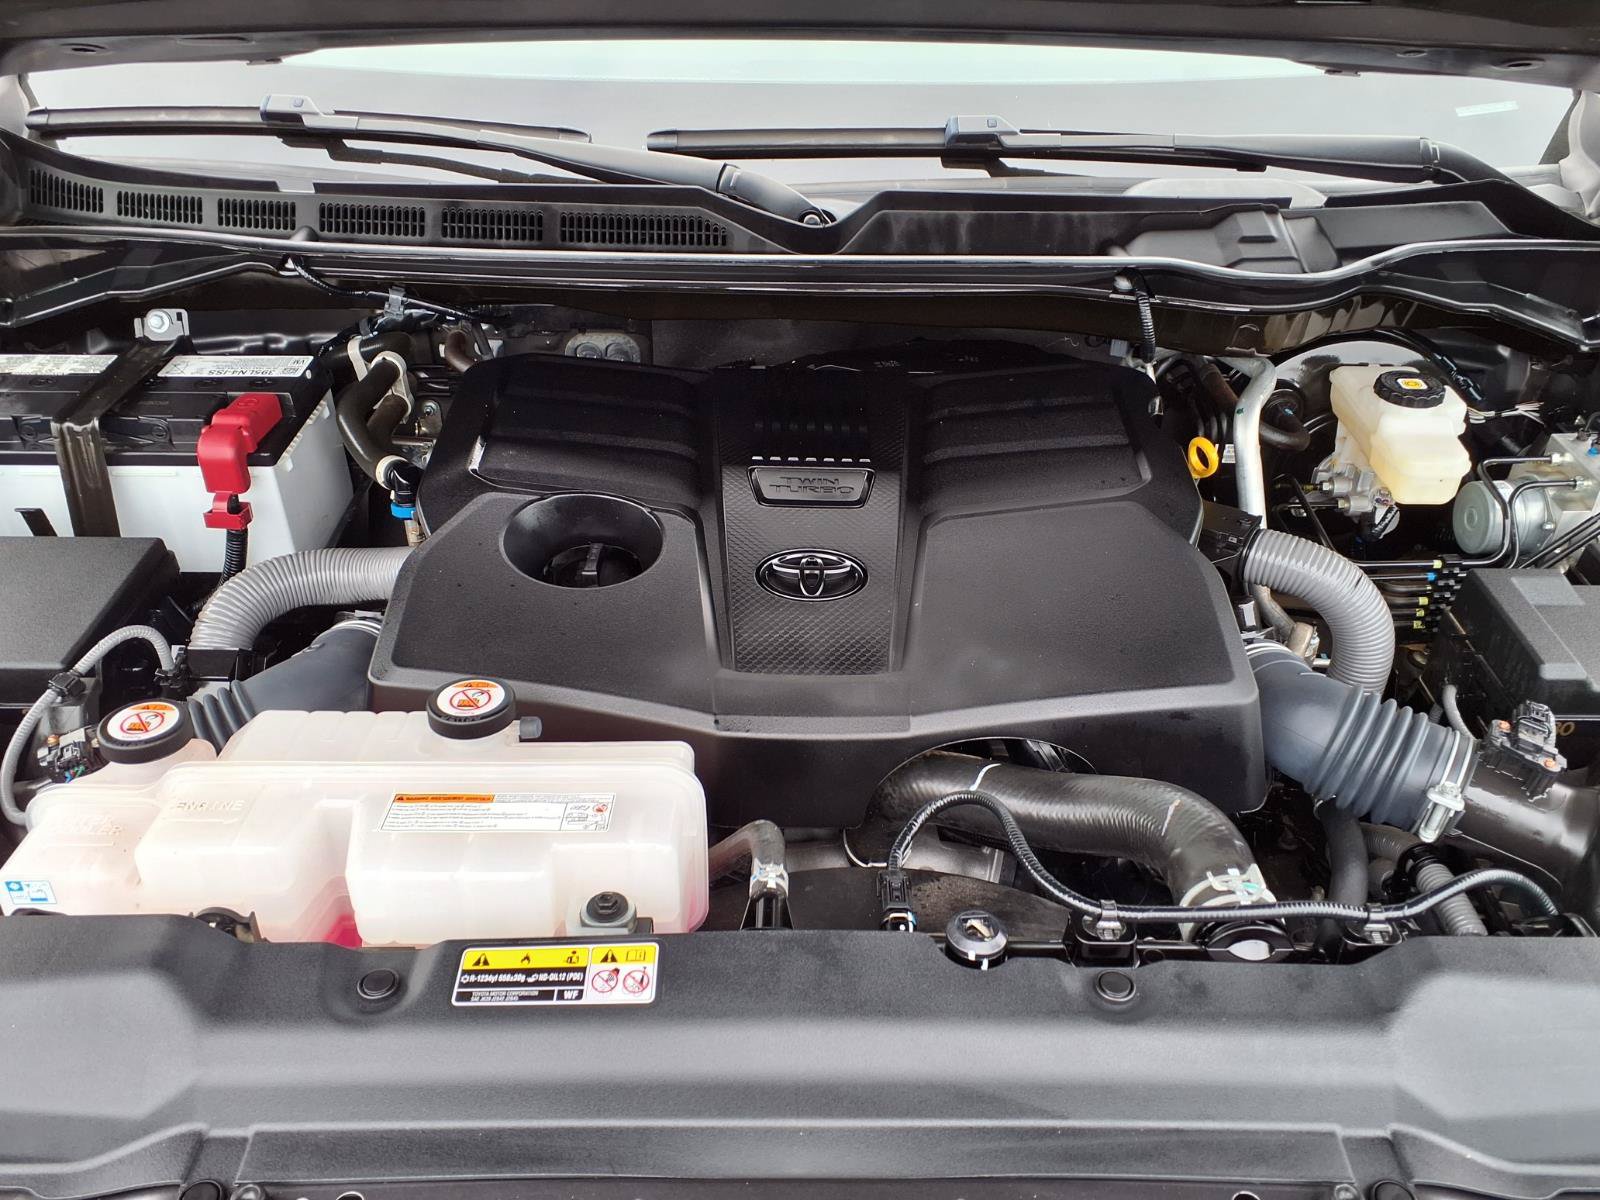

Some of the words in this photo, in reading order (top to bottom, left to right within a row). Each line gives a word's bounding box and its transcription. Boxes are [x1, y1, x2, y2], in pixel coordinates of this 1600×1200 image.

[780, 476, 839, 485] TWIN
[769, 484, 854, 494] TURBO
[175, 800, 245, 811] ENGINE
[563, 990, 579, 1000] WF
